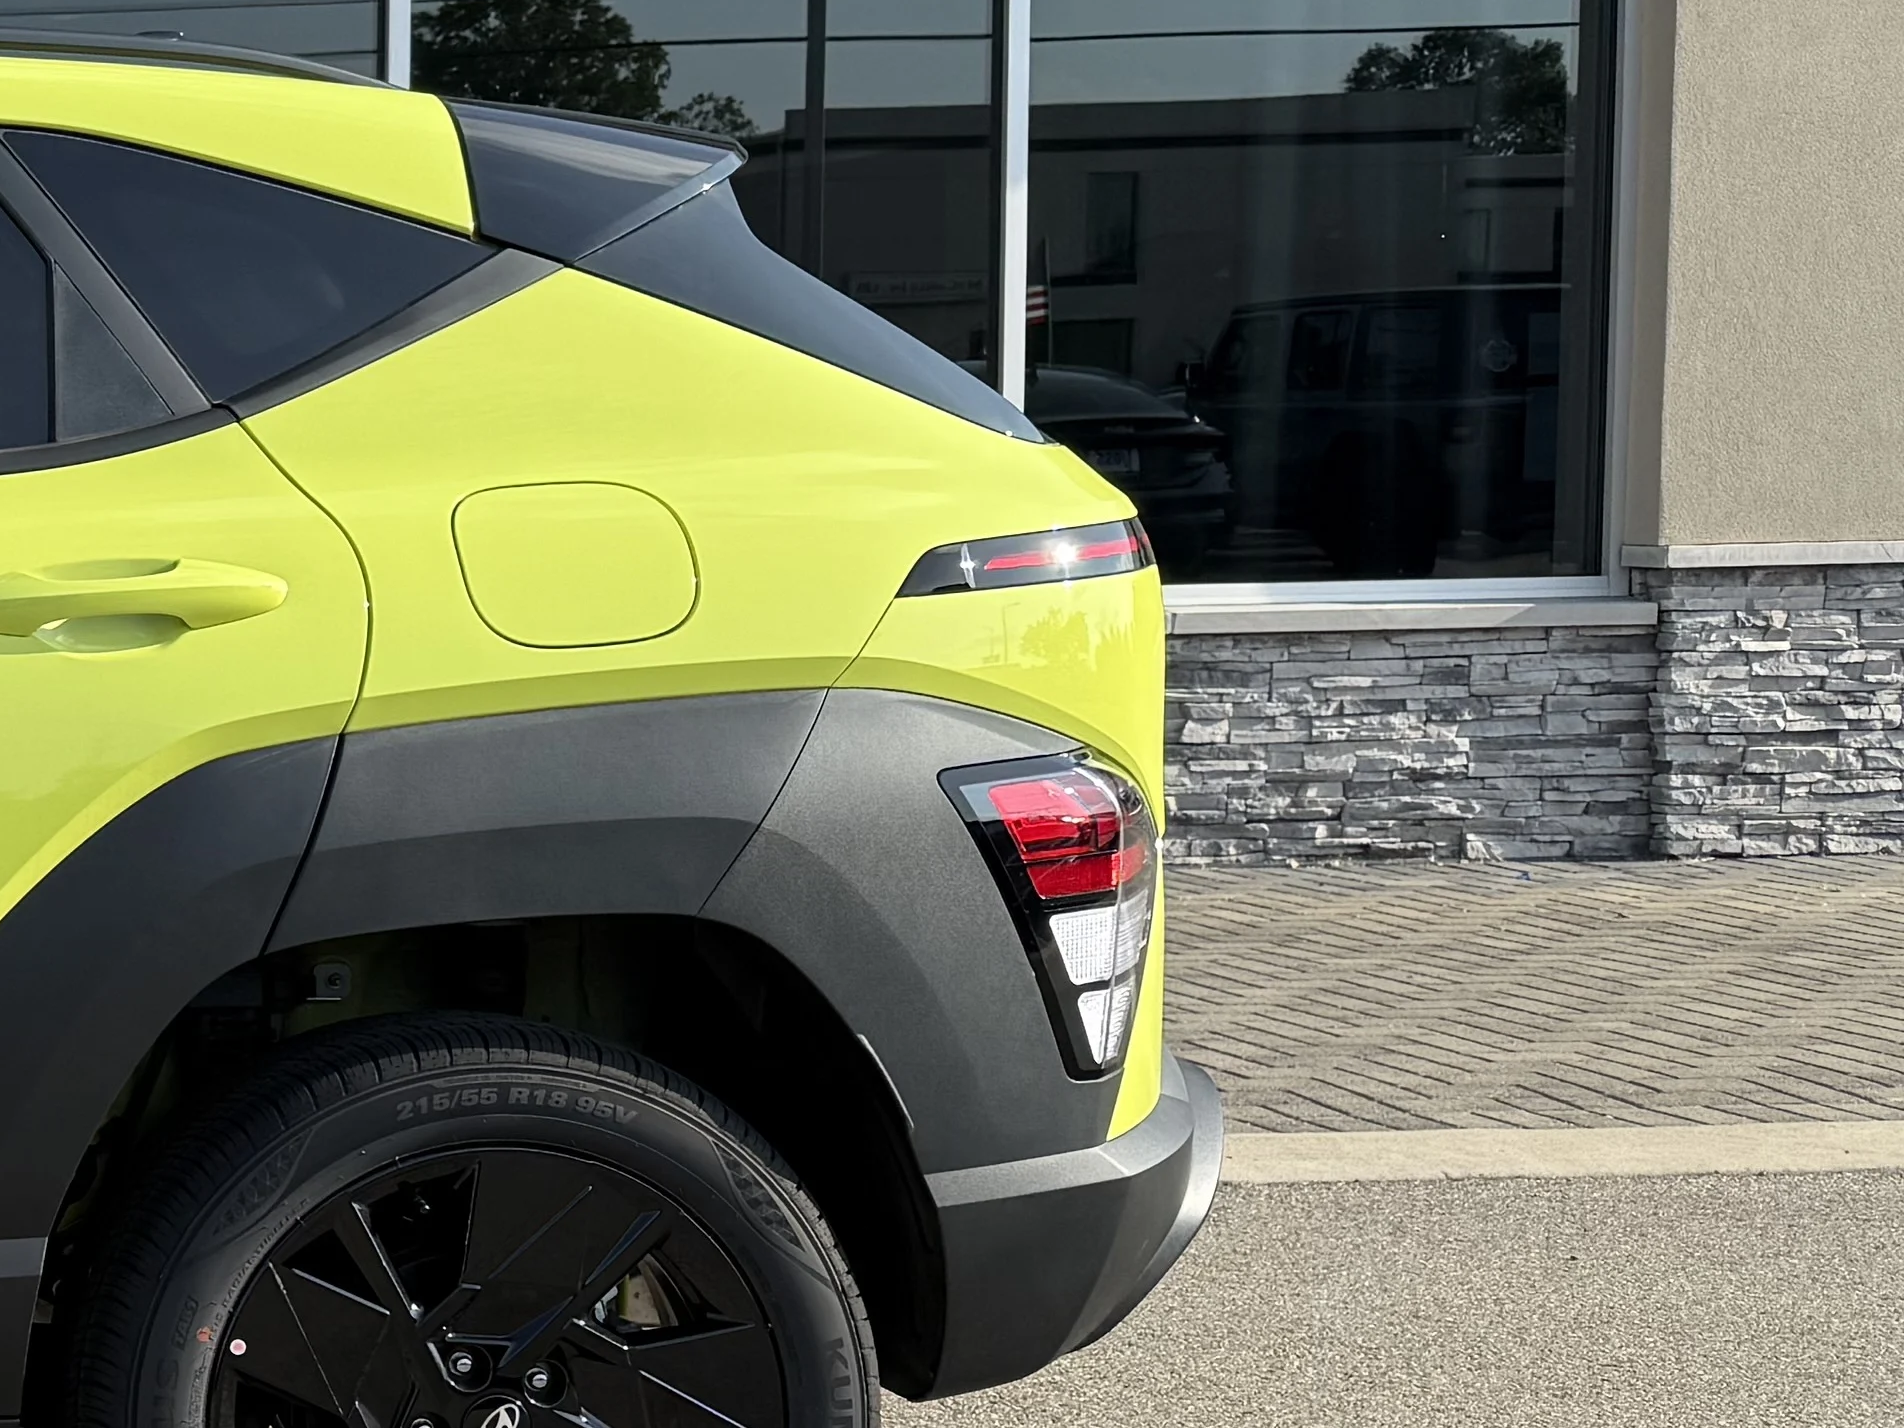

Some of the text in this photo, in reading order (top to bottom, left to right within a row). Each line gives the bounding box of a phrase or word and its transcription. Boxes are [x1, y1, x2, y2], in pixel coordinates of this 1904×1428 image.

[396, 1085, 639, 1130] 215/55 R18 95V
